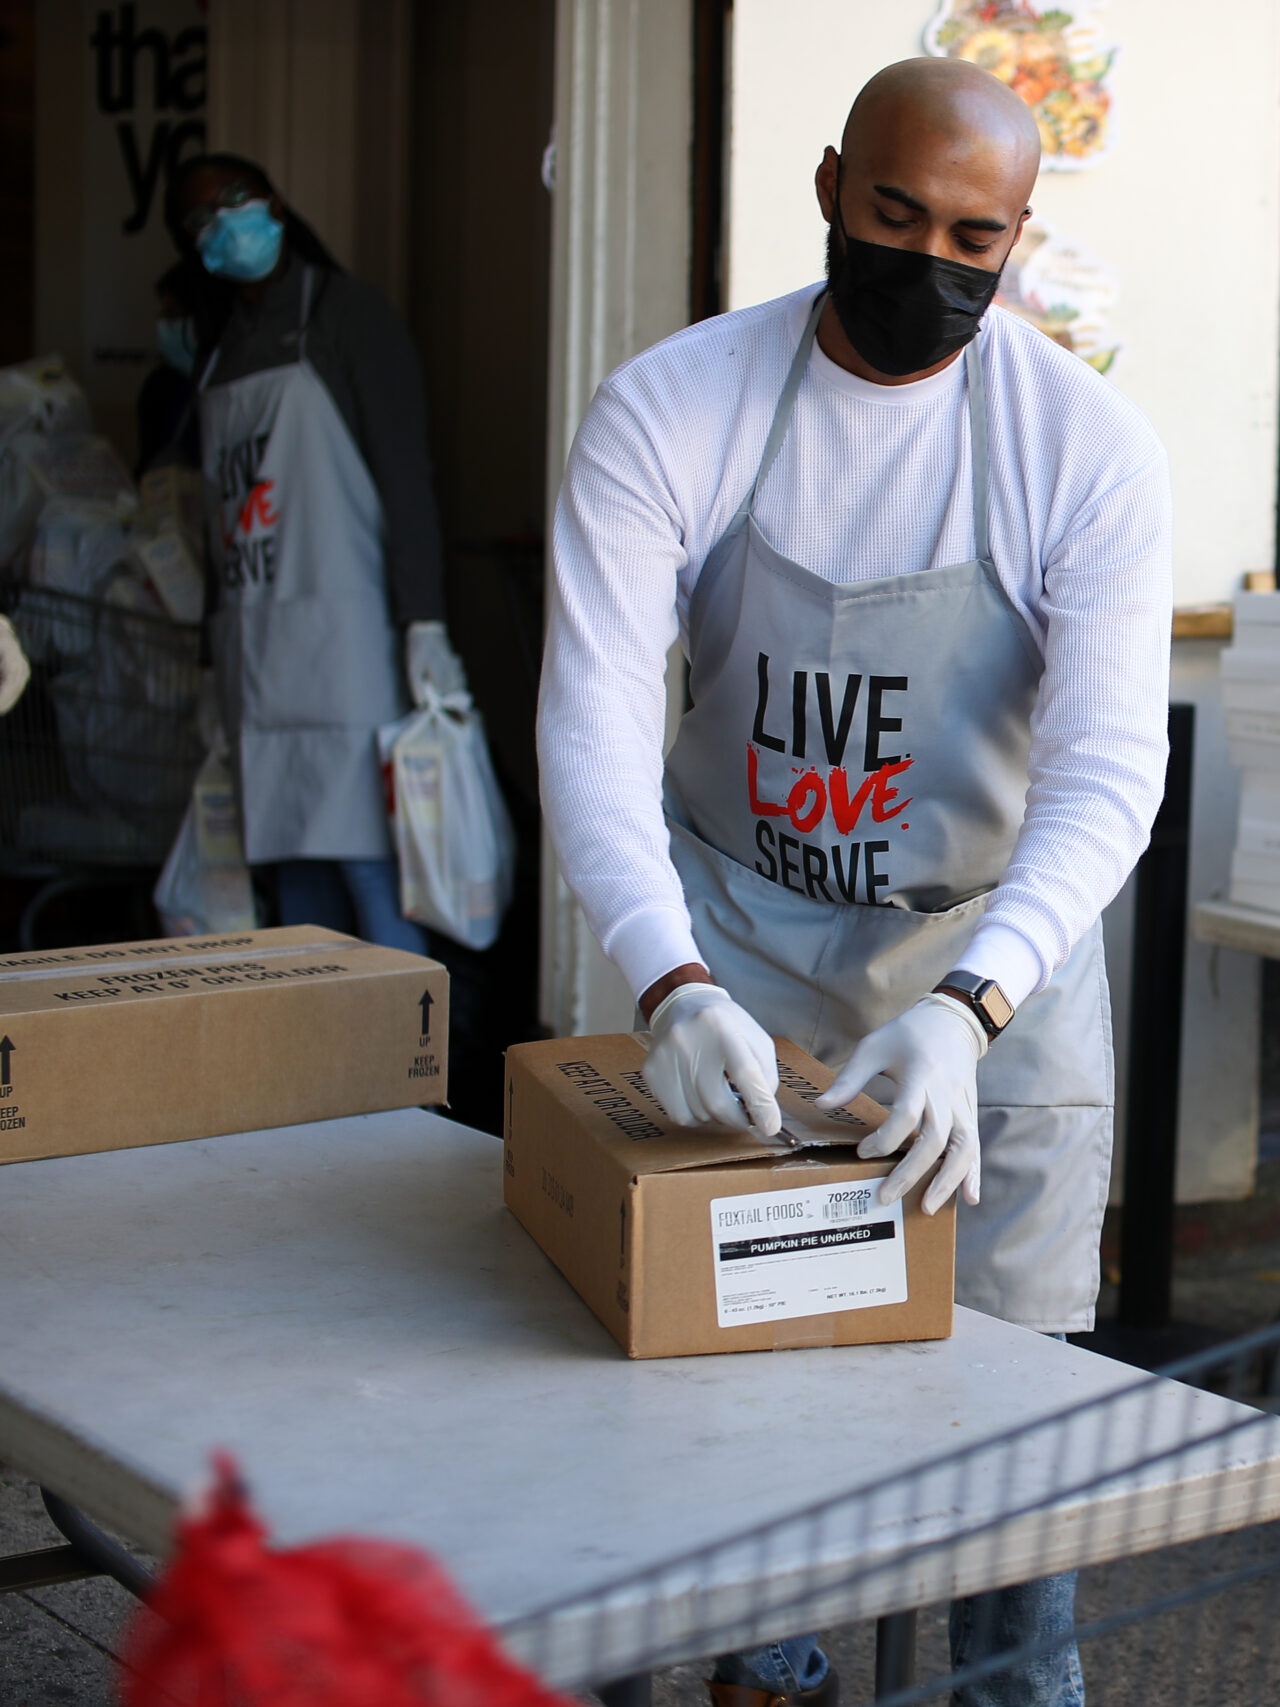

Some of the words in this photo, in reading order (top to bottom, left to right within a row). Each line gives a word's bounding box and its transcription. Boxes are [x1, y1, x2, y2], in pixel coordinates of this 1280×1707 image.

[752, 651, 910, 773] LIVE
[754, 819, 895, 908] SERVE
[0, 953, 85, 968] AGILE
[85, 949, 126, 960] DO
[129, 945, 181, 956] NOT
[185, 937, 254, 950] DROP
[53, 987, 122, 1001] KEEP
[130, 982, 165, 994] AT
[200, 975, 243, 986] OR
[244, 964, 348, 981] COLDER
[97, 966, 204, 986] FROZEN
[204, 962, 266, 975] PIES
[419, 1035, 431, 1048] UP
[414, 1055, 435, 1067] KEEP
[555, 1060, 600, 1078] KEEP
[408, 1064, 440, 1079] FROZEN
[572, 1078, 612, 1088] AT
[0, 1086, 13, 1098] UP
[593, 1096, 632, 1110] OR
[0, 1106, 19, 1119] EEP
[0, 1117, 26, 1131] OZEN
[606, 1108, 665, 1142] COLDER
[827, 1188, 872, 1204] 702225
[718, 1208, 763, 1228] FOXTAIL
[766, 1202, 804, 1222] FOODS
[750, 1239, 799, 1254] PUMPKIN
[801, 1236, 818, 1247] PIE
[820, 1229, 871, 1245] UNBAKED
